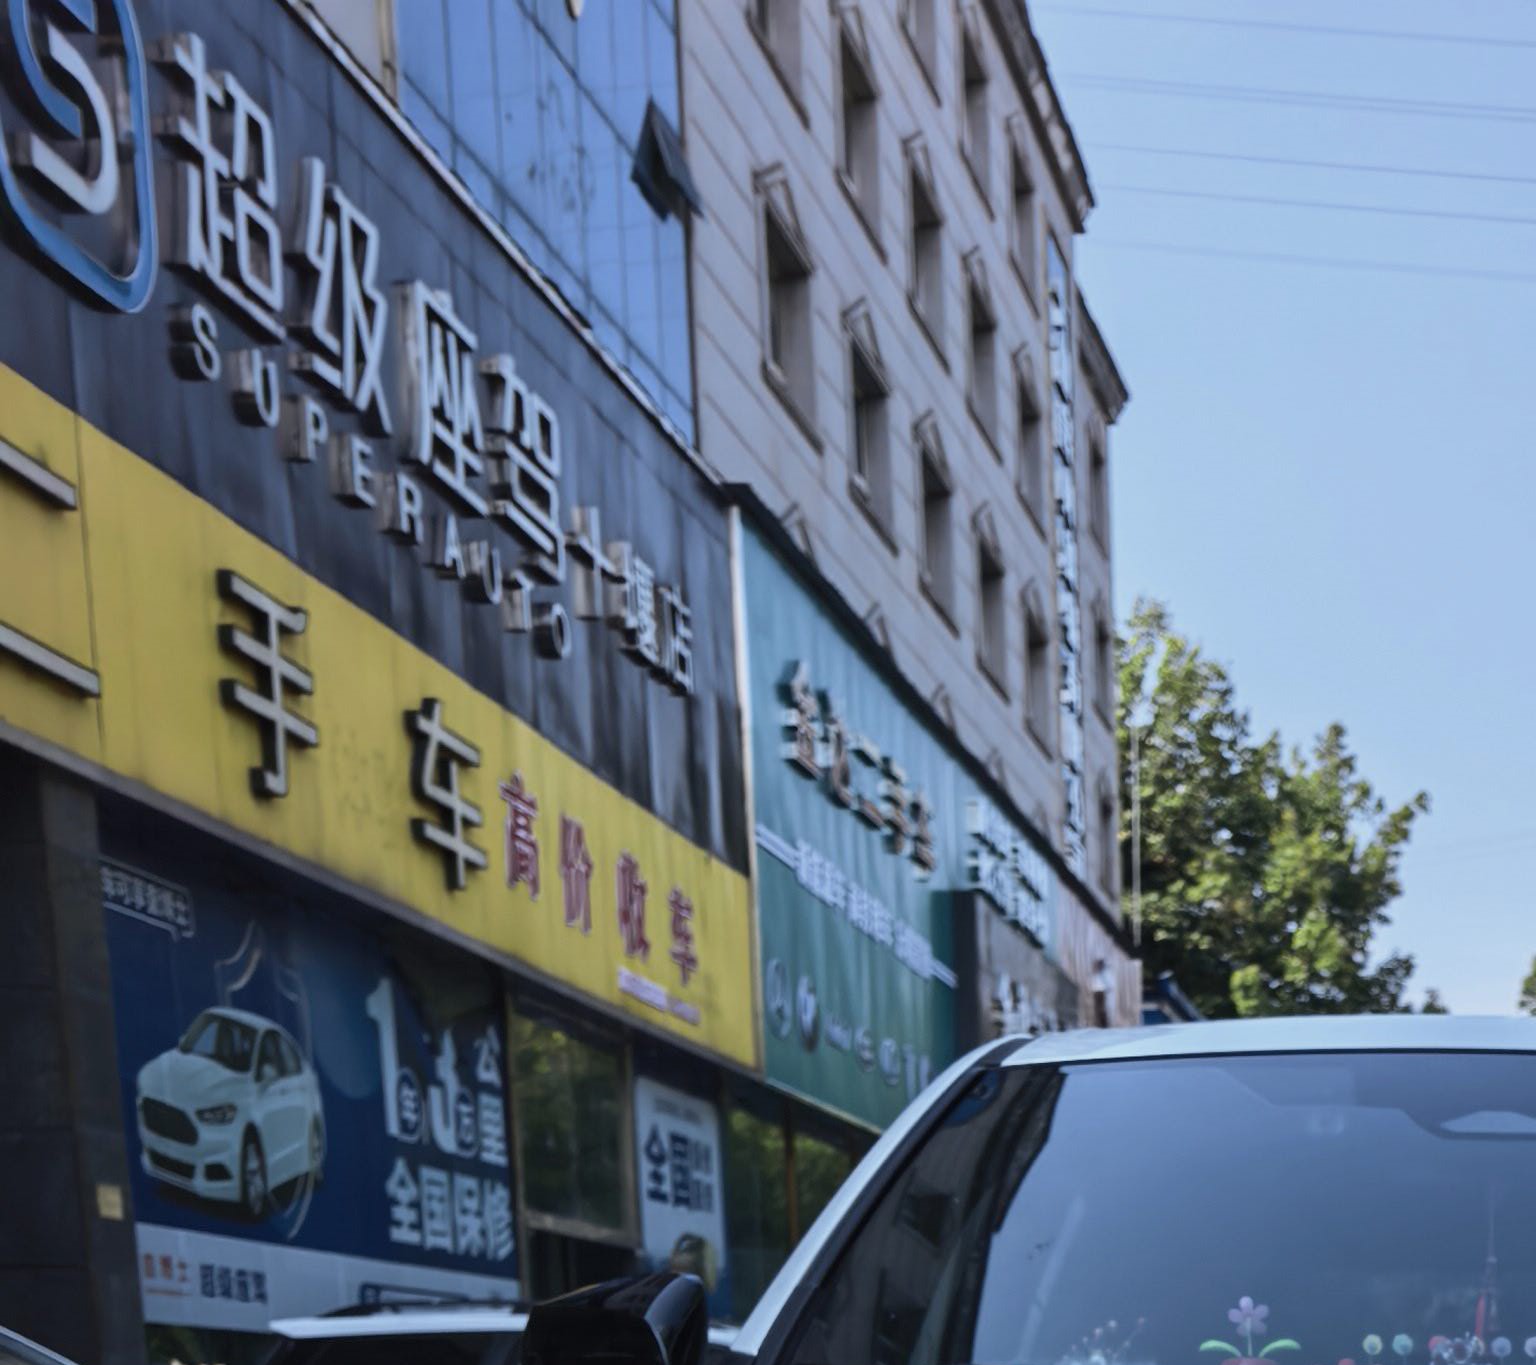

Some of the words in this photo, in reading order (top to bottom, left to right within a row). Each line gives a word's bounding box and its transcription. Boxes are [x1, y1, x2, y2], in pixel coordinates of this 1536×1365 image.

[168, 33, 566, 584] 超级座驾
[0, 436, 487, 892] 二手车
[498, 768, 698, 984] 高价收车
